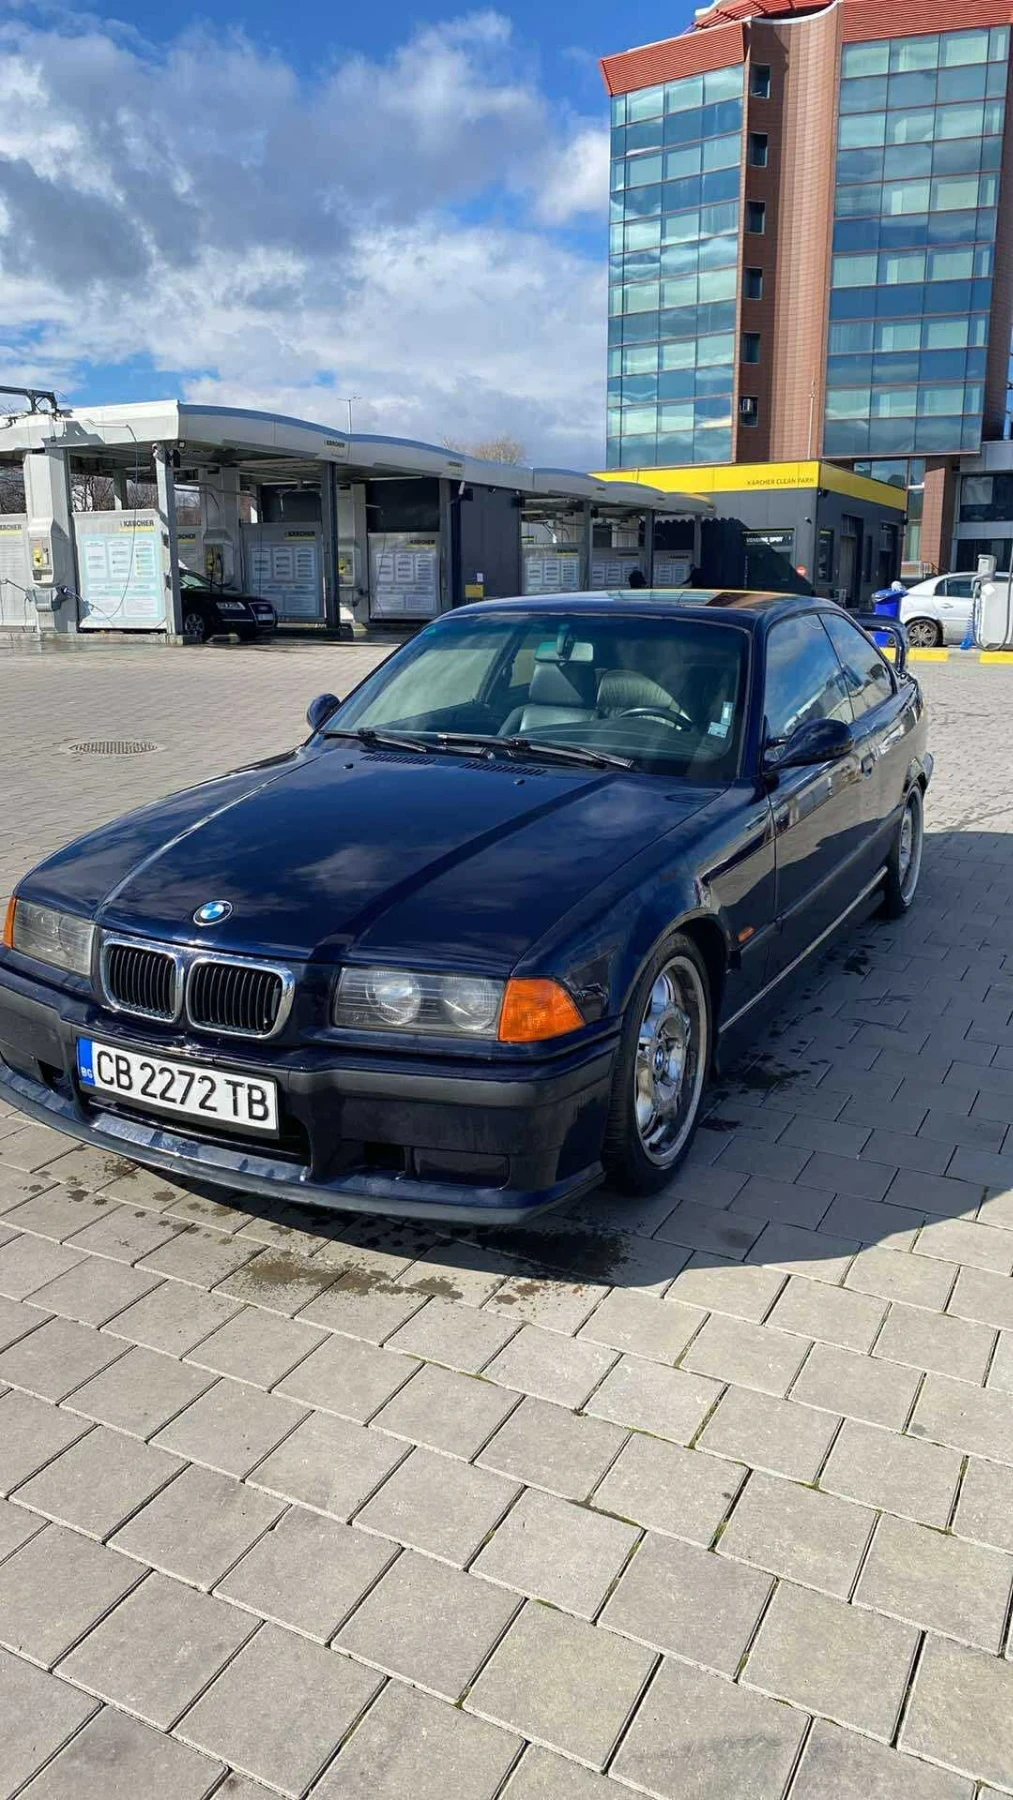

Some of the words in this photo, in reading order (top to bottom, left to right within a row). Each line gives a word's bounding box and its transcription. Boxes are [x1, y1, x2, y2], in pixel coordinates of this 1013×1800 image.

[80, 1066, 94, 1079] BG
[96, 1050, 133, 1091] CB
[139, 1062, 218, 1112] 2272
[224, 1079, 270, 1121] TB
